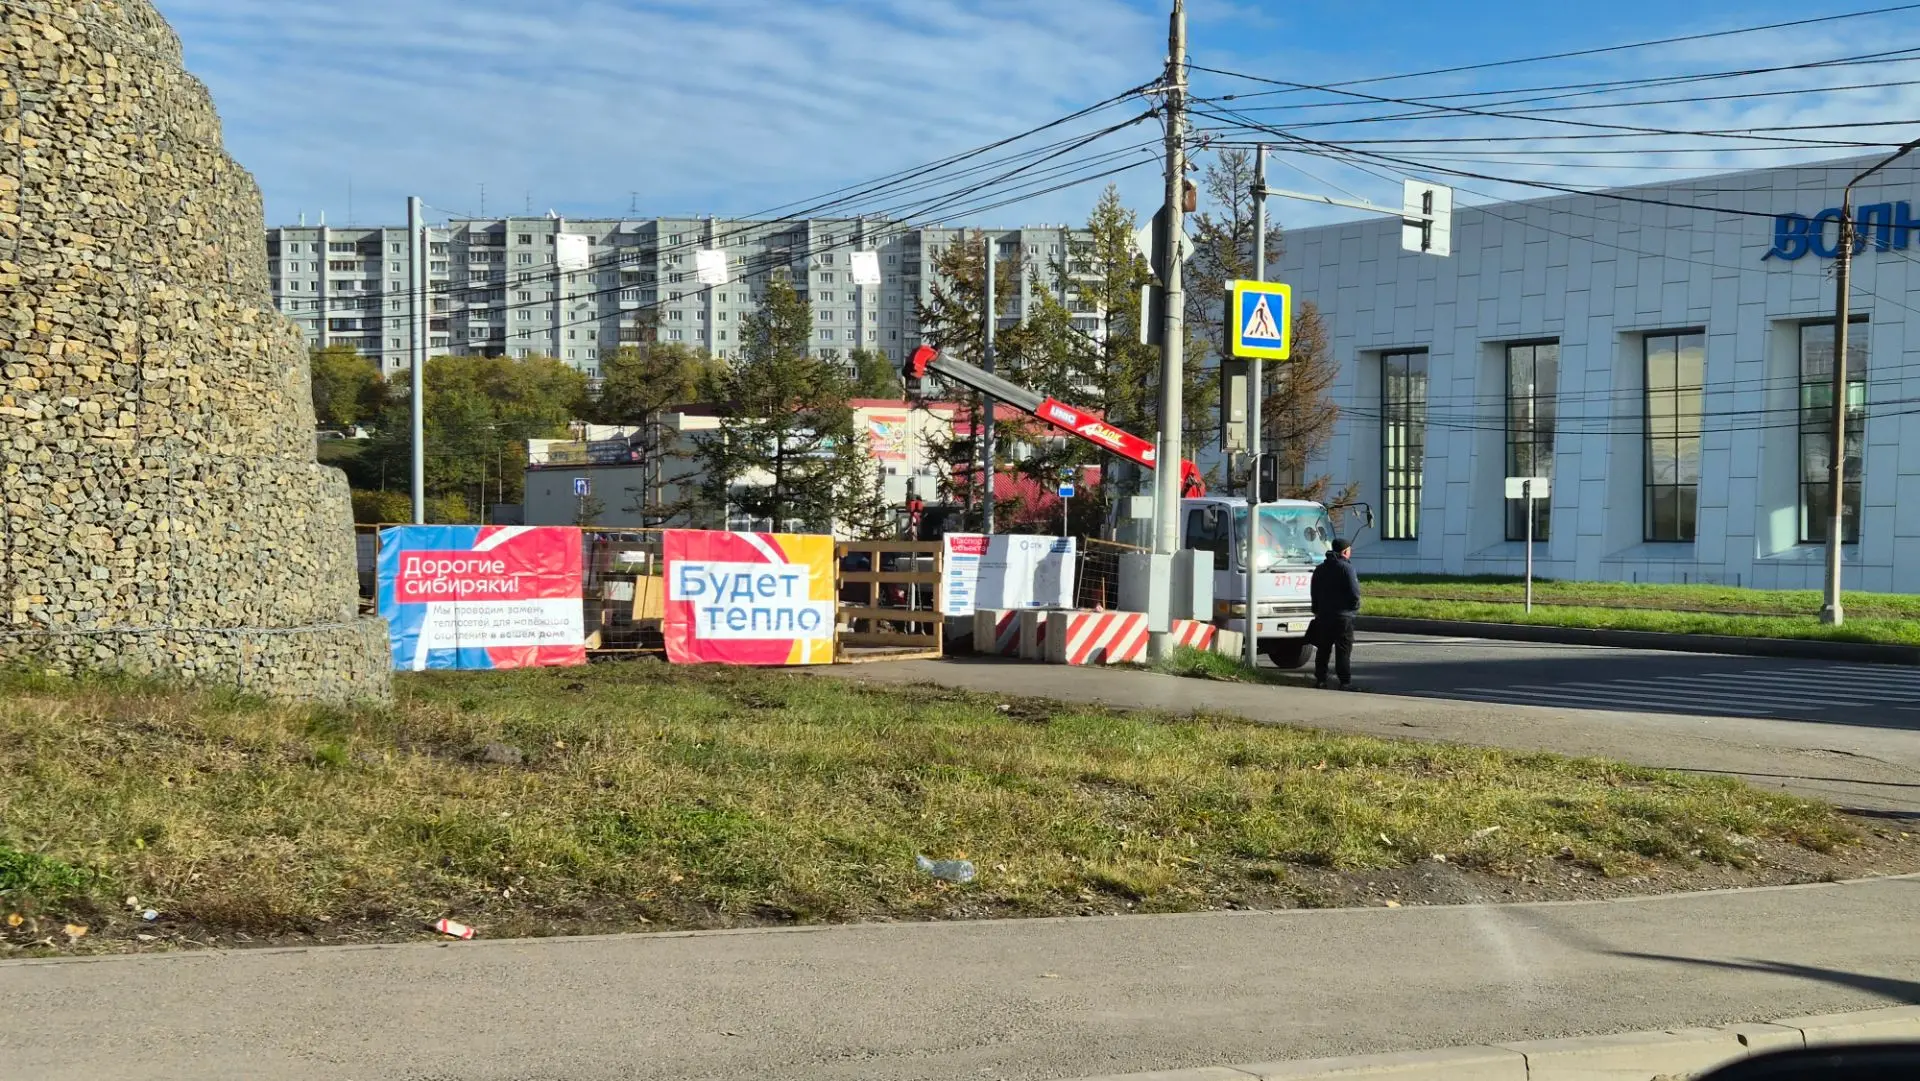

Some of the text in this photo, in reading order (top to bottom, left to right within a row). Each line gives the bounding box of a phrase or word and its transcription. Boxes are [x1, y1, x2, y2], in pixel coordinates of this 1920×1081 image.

[952, 537, 987, 546] Паспорт
[952, 544, 986, 553] объекта
[404, 556, 506, 579] Дорогие
[405, 575, 520, 597] сибиряки!
[680, 565, 799, 604] Будет
[1275, 575, 1291, 586] 271
[433, 605, 451, 615] Мы
[455, 605, 504, 617] проводим
[433, 617, 489, 628] теплосетей
[493, 619, 511, 628] для
[703, 607, 821, 631] тепло
[434, 632, 487, 641] отопления
[500, 631, 536, 639] вашем
[539, 630, 565, 640] доме
